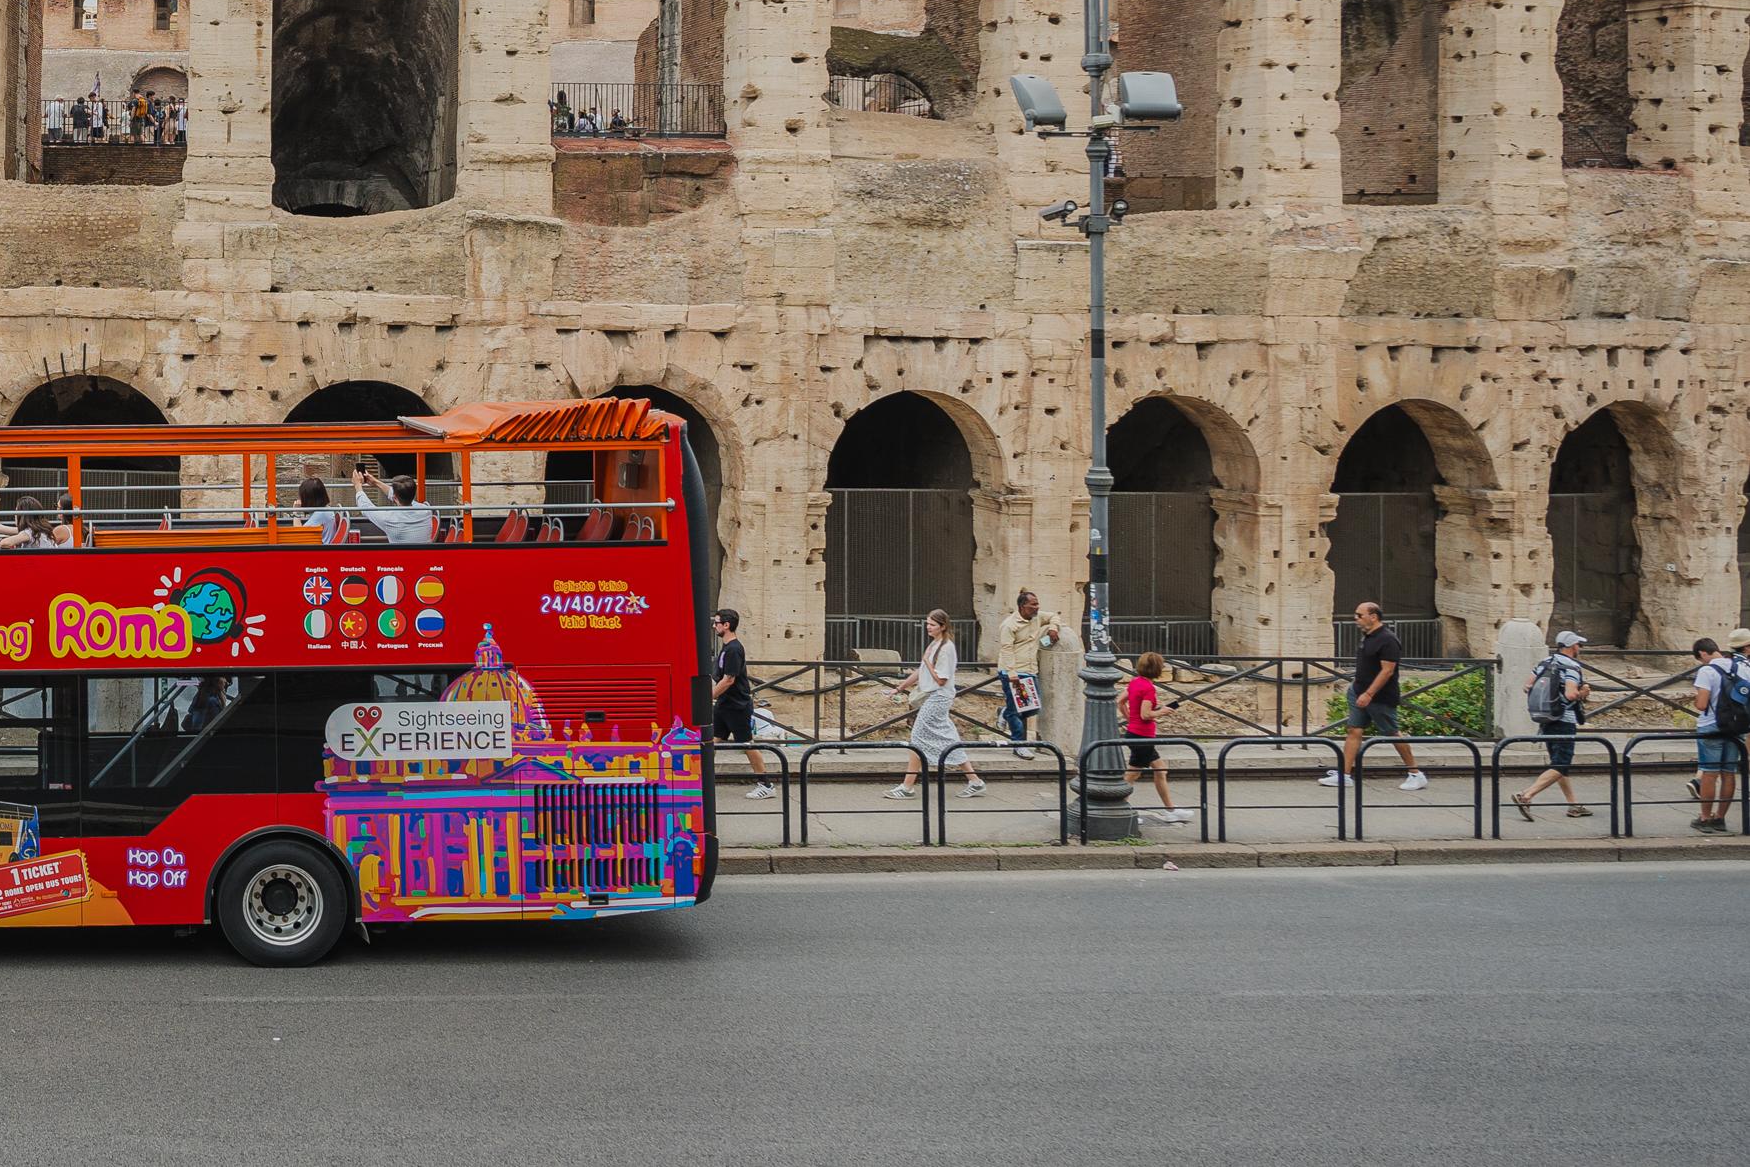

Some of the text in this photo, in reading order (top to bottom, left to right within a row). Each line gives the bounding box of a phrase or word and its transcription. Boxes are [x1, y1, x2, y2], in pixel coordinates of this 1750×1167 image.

[305, 566, 329, 574] English
[553, 580, 629, 594] Biglietto Valido
[50, 593, 193, 659] Roma
[558, 615, 622, 630] Valid Ticket
[341, 640, 368, 650] 中国人
[397, 709, 505, 730] Sightseeing
[341, 727, 507, 757] EXPERIENCE
[128, 848, 185, 867] Hop On
[10, 867, 21, 886] 1
[128, 868, 187, 888] Hop Off
[4, 887, 25, 898] ROME
[25, 883, 45, 894] OPEN
[45, 879, 60, 889] BUS
